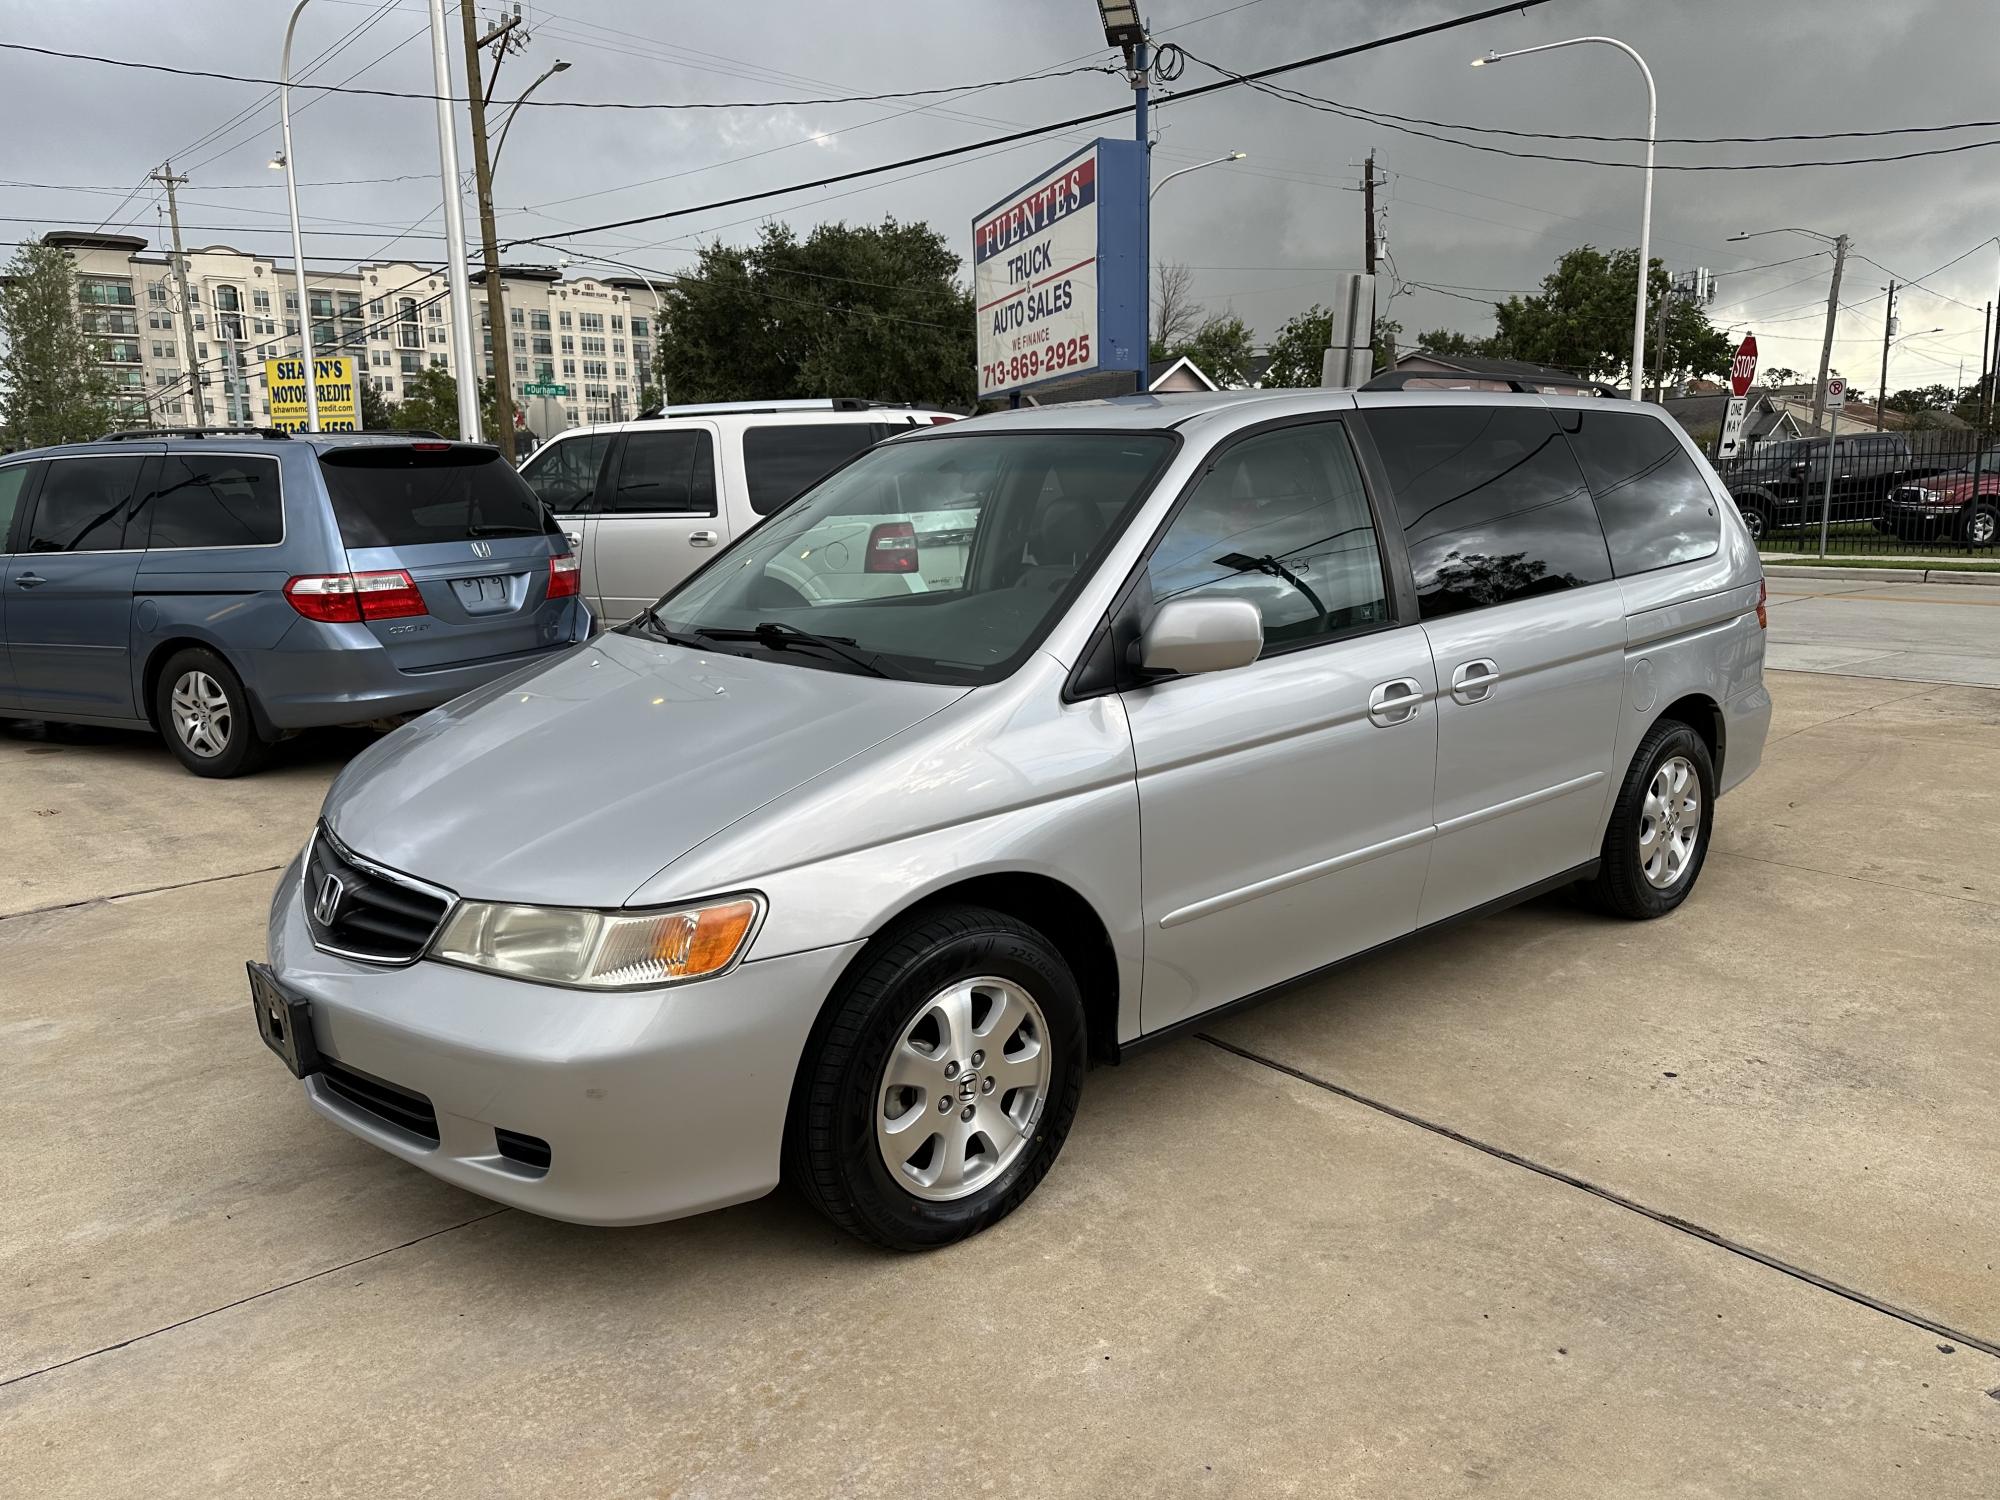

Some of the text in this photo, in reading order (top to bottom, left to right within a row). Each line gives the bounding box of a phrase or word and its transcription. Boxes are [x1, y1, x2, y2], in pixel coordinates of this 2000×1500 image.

[985, 170, 1081, 258] FUENTES
[1008, 240, 1052, 285] TRUCK
[1026, 280, 1031, 294] &
[993, 279, 1072, 336] AUTO SALES
[1012, 328, 1050, 350] WE FINANCE
[983, 334, 1090, 389] 713-869-2925
[1734, 355, 1756, 378] STOP
[530, 385, 556, 394] Durham
[274, 405, 352, 413] shawnsmocredit.com
[1731, 403, 1743, 416] ONE
[1726, 420, 1740, 432] WAY
